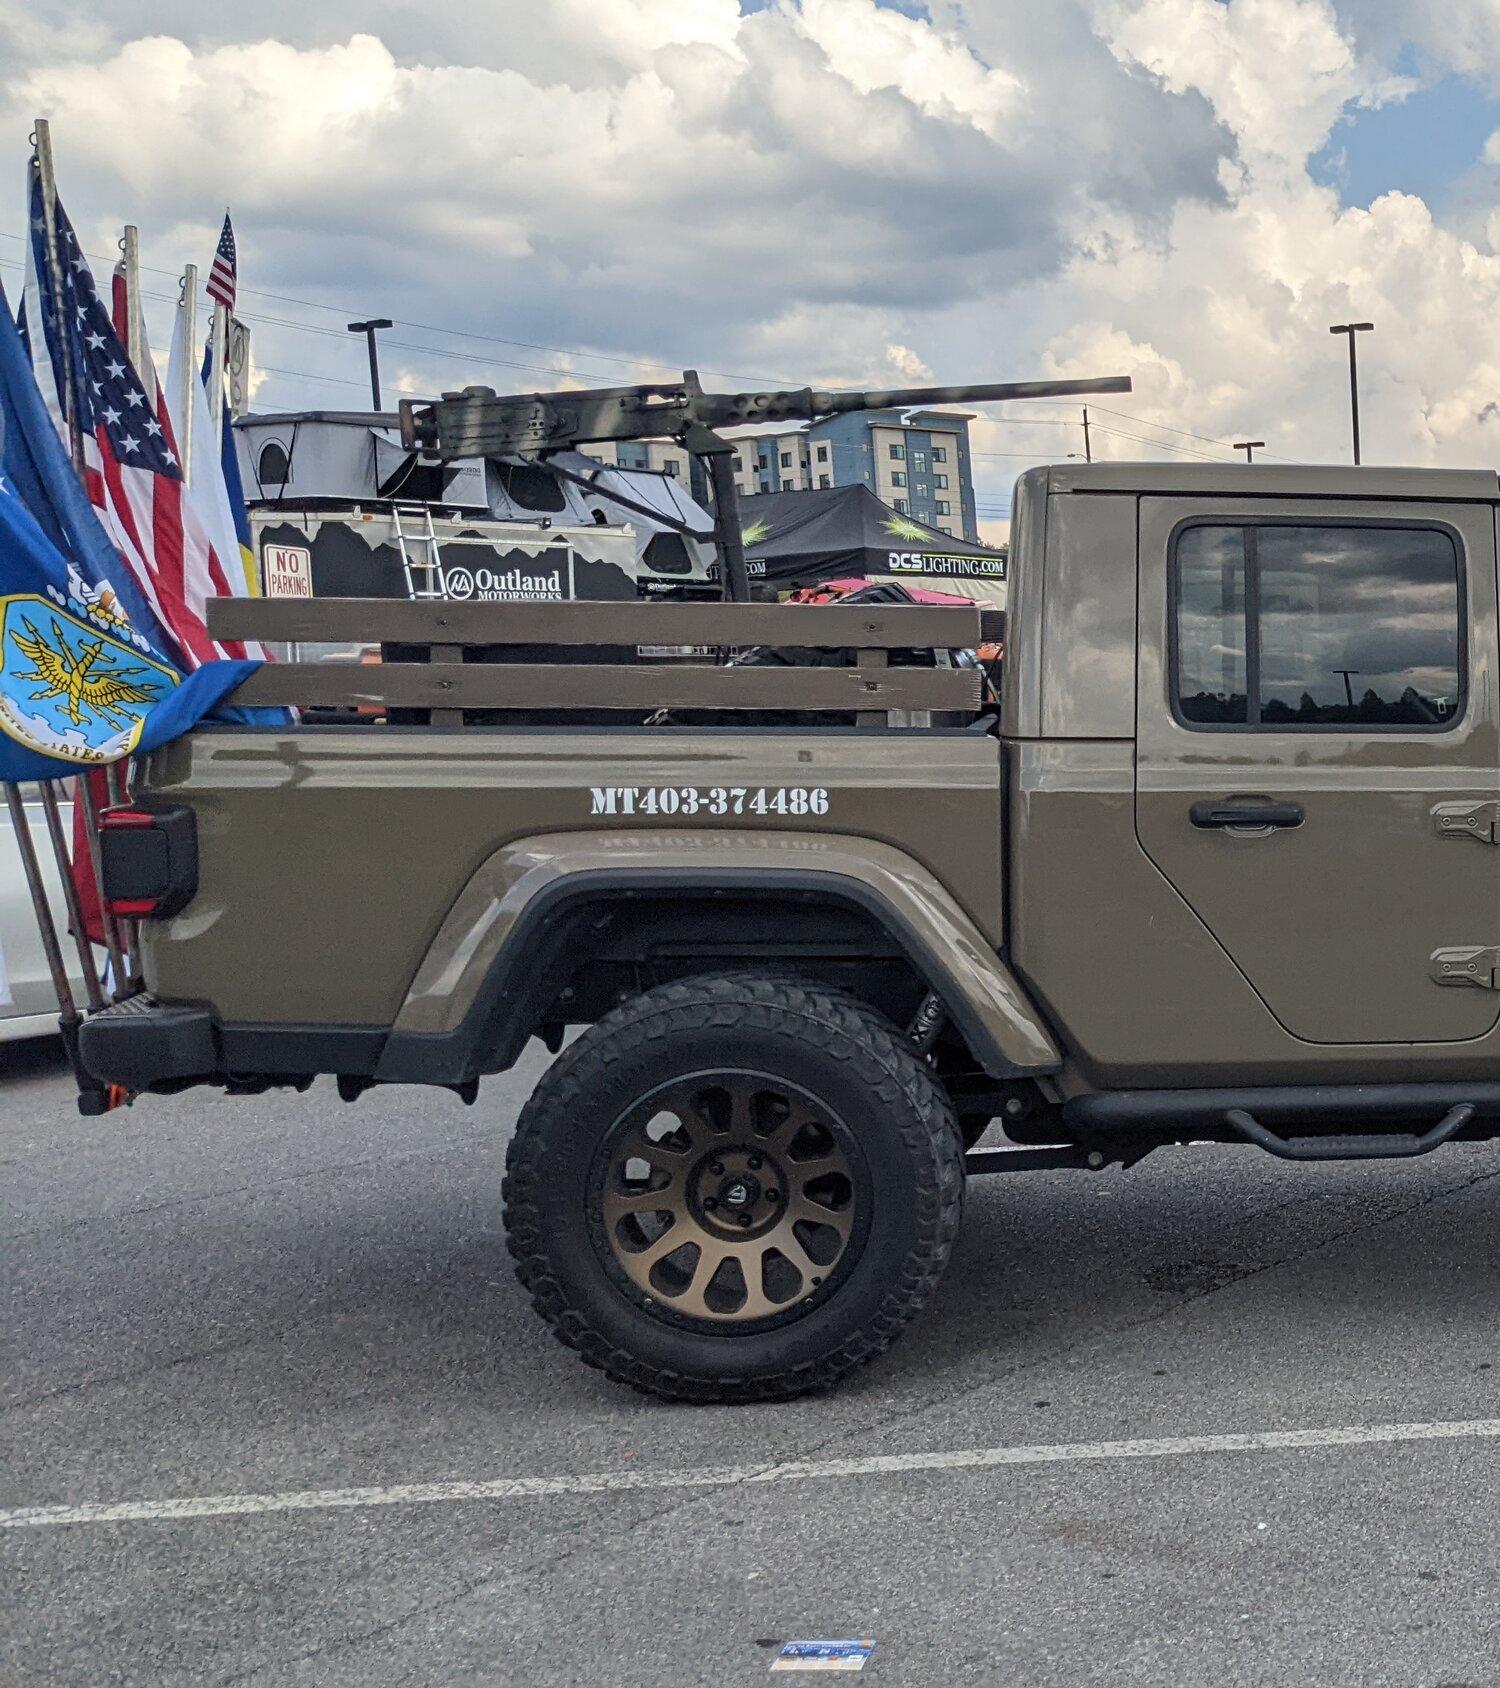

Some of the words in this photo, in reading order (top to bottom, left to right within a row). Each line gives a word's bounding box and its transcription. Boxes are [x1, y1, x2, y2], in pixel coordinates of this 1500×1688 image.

[276, 551, 299, 573] NO
[271, 574, 308, 596] PARKING
[475, 568, 561, 592] Outland
[478, 590, 562, 600] MOTORWORKS
[590, 787, 830, 815] MT403-374486
